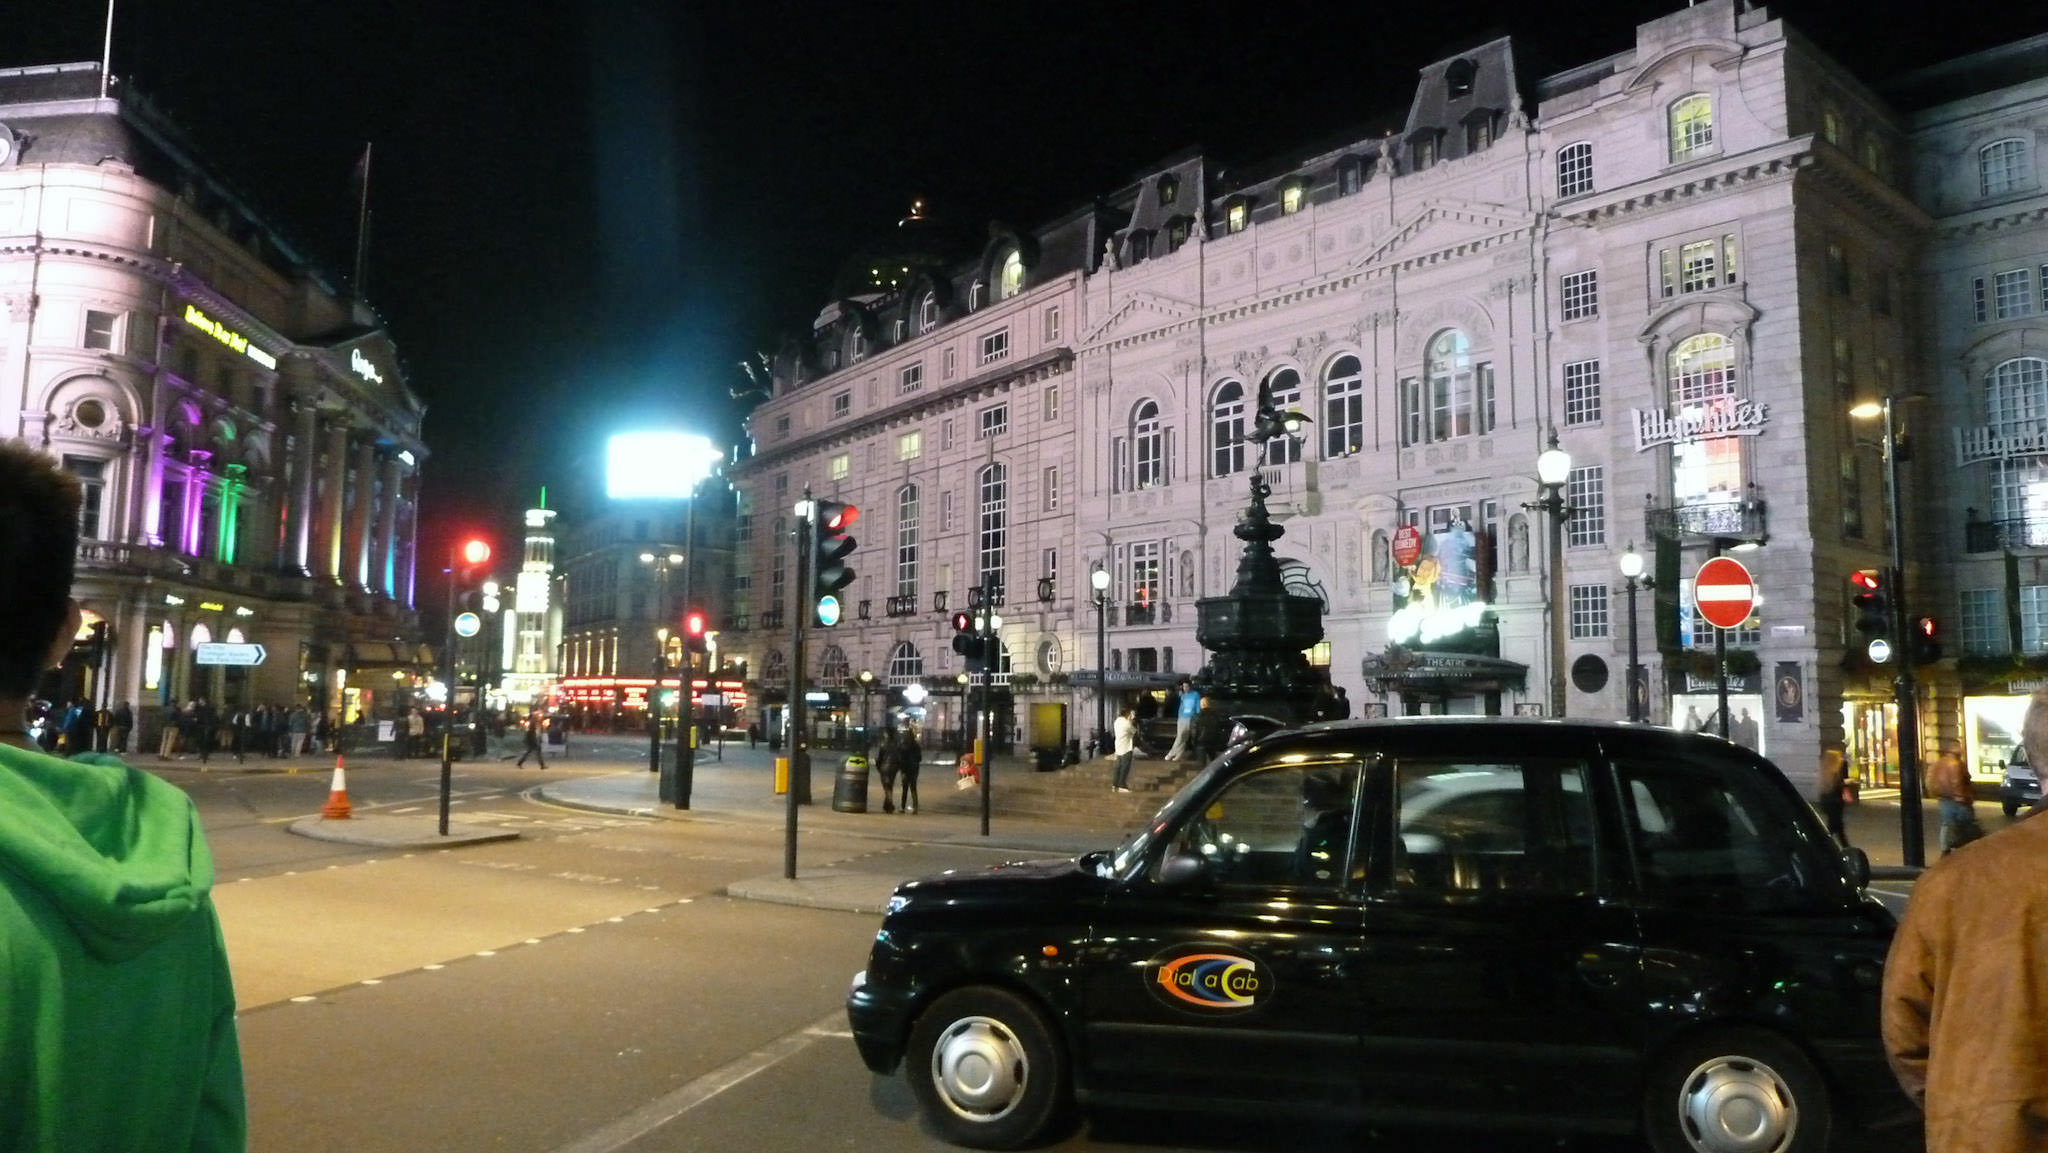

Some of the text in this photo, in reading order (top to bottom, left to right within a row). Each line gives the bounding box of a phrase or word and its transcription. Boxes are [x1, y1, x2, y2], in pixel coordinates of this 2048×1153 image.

[1631, 397, 1767, 453] Lillywhites
[1426, 657, 1467, 668] THEATRE
[1157, 962, 1259, 1003] Dial a Cab
